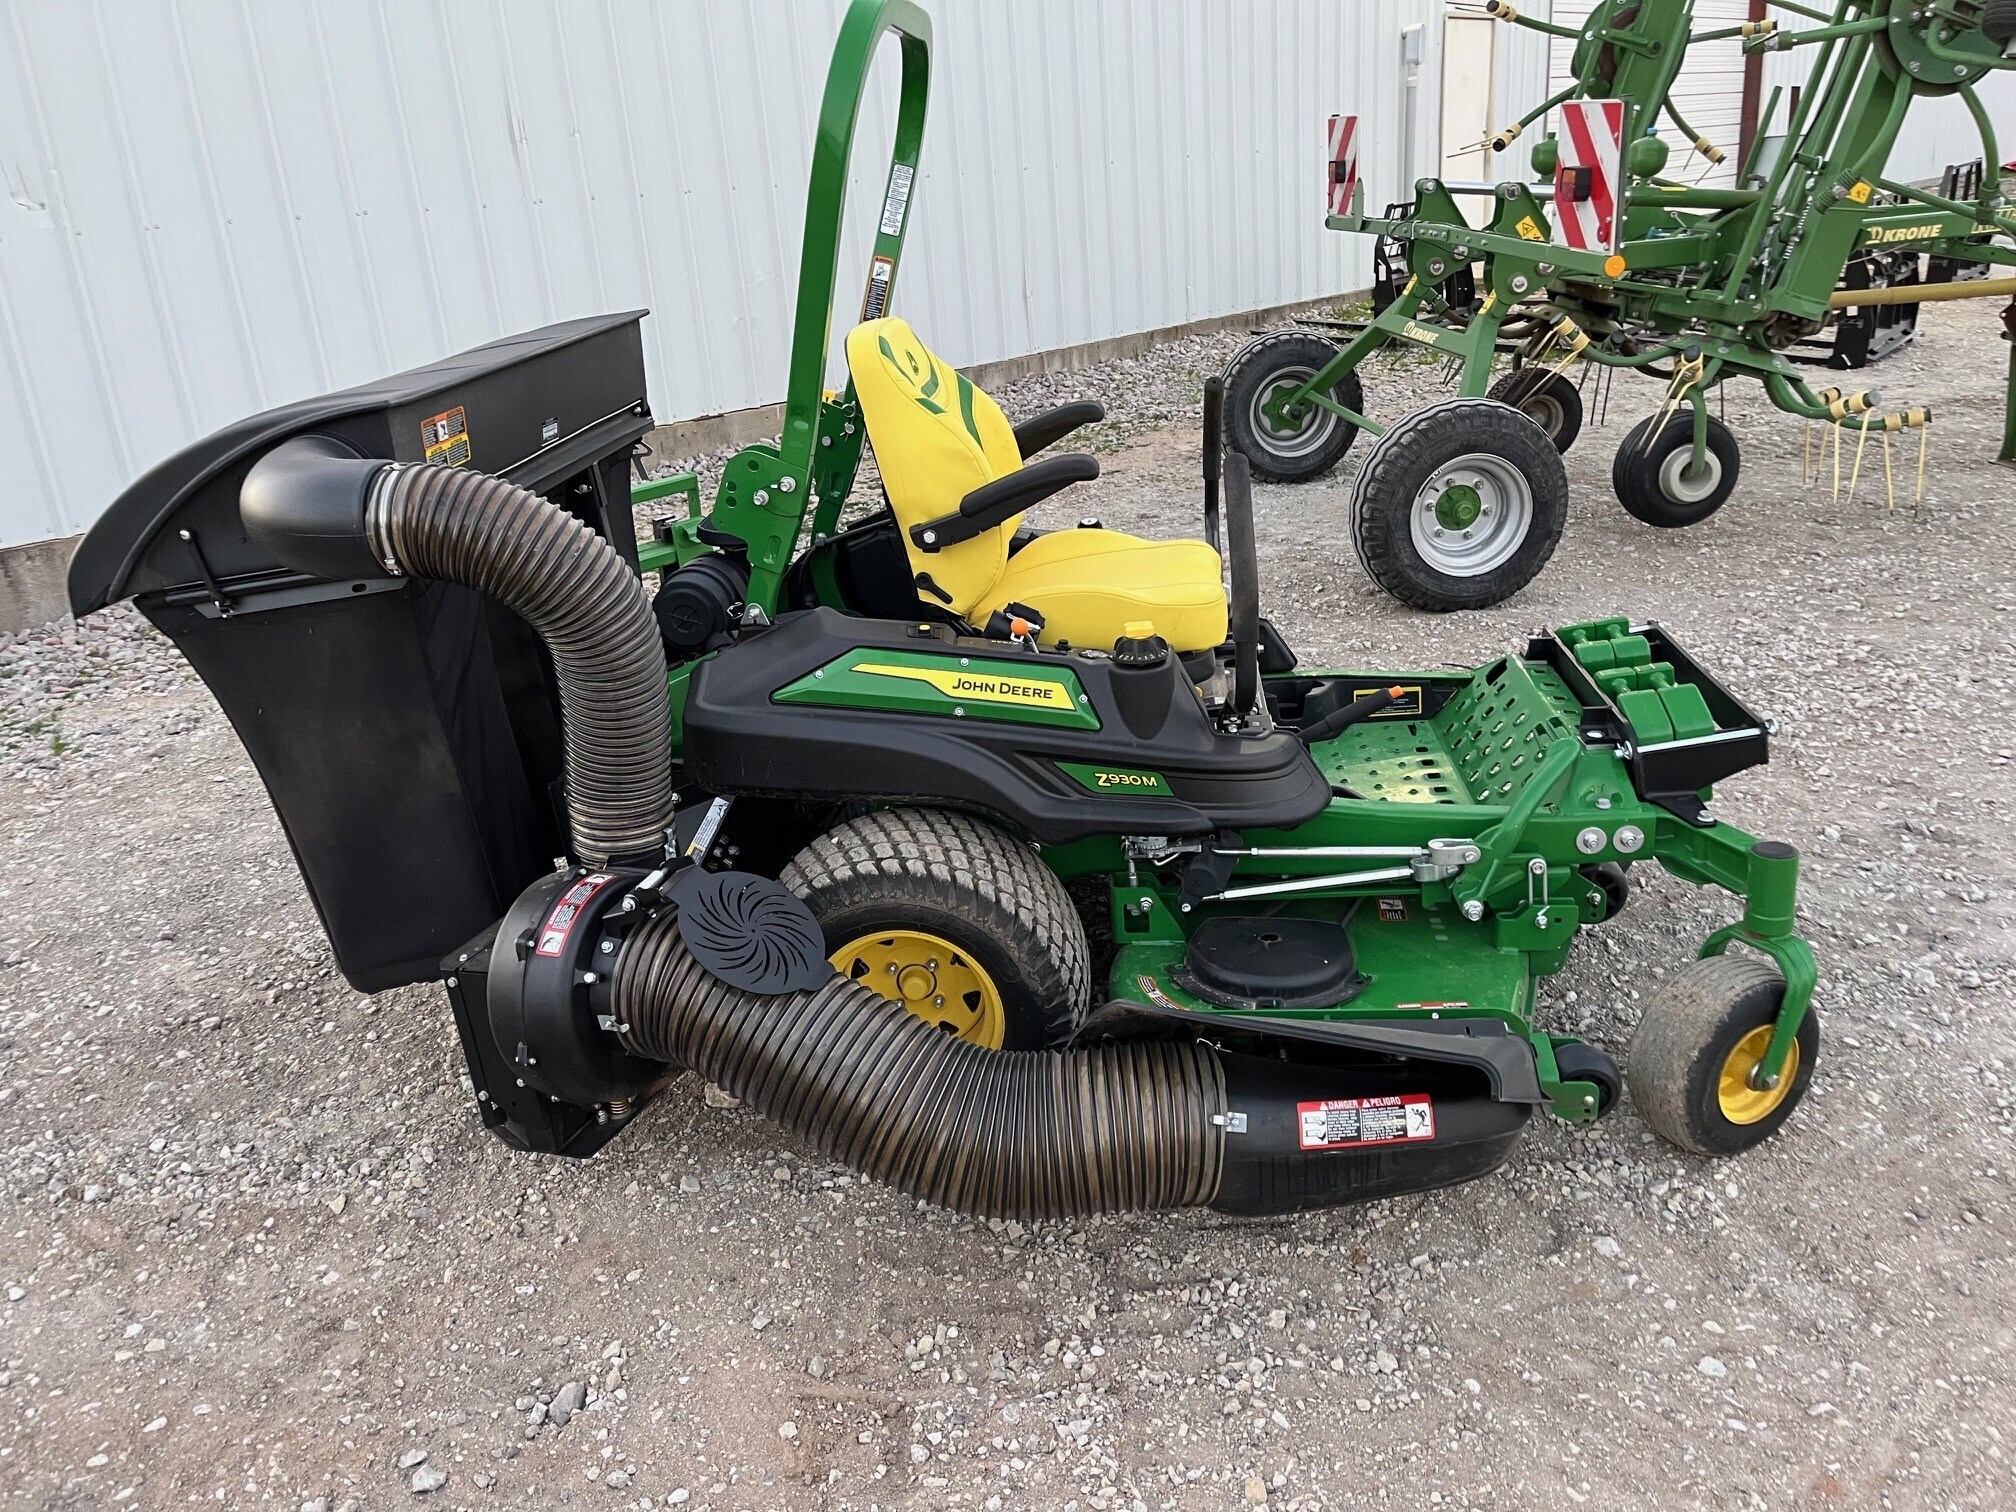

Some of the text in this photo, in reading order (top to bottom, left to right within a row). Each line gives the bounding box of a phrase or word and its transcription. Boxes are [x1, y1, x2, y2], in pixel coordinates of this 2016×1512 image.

[1883, 225, 1943, 242] KRONE
[1408, 326, 1439, 344] KRONE
[952, 678, 1053, 699] JOHN DEERE
[1094, 773, 1158, 787] Z930M
[1328, 1096, 1401, 1110] DANGER PELIGRO
